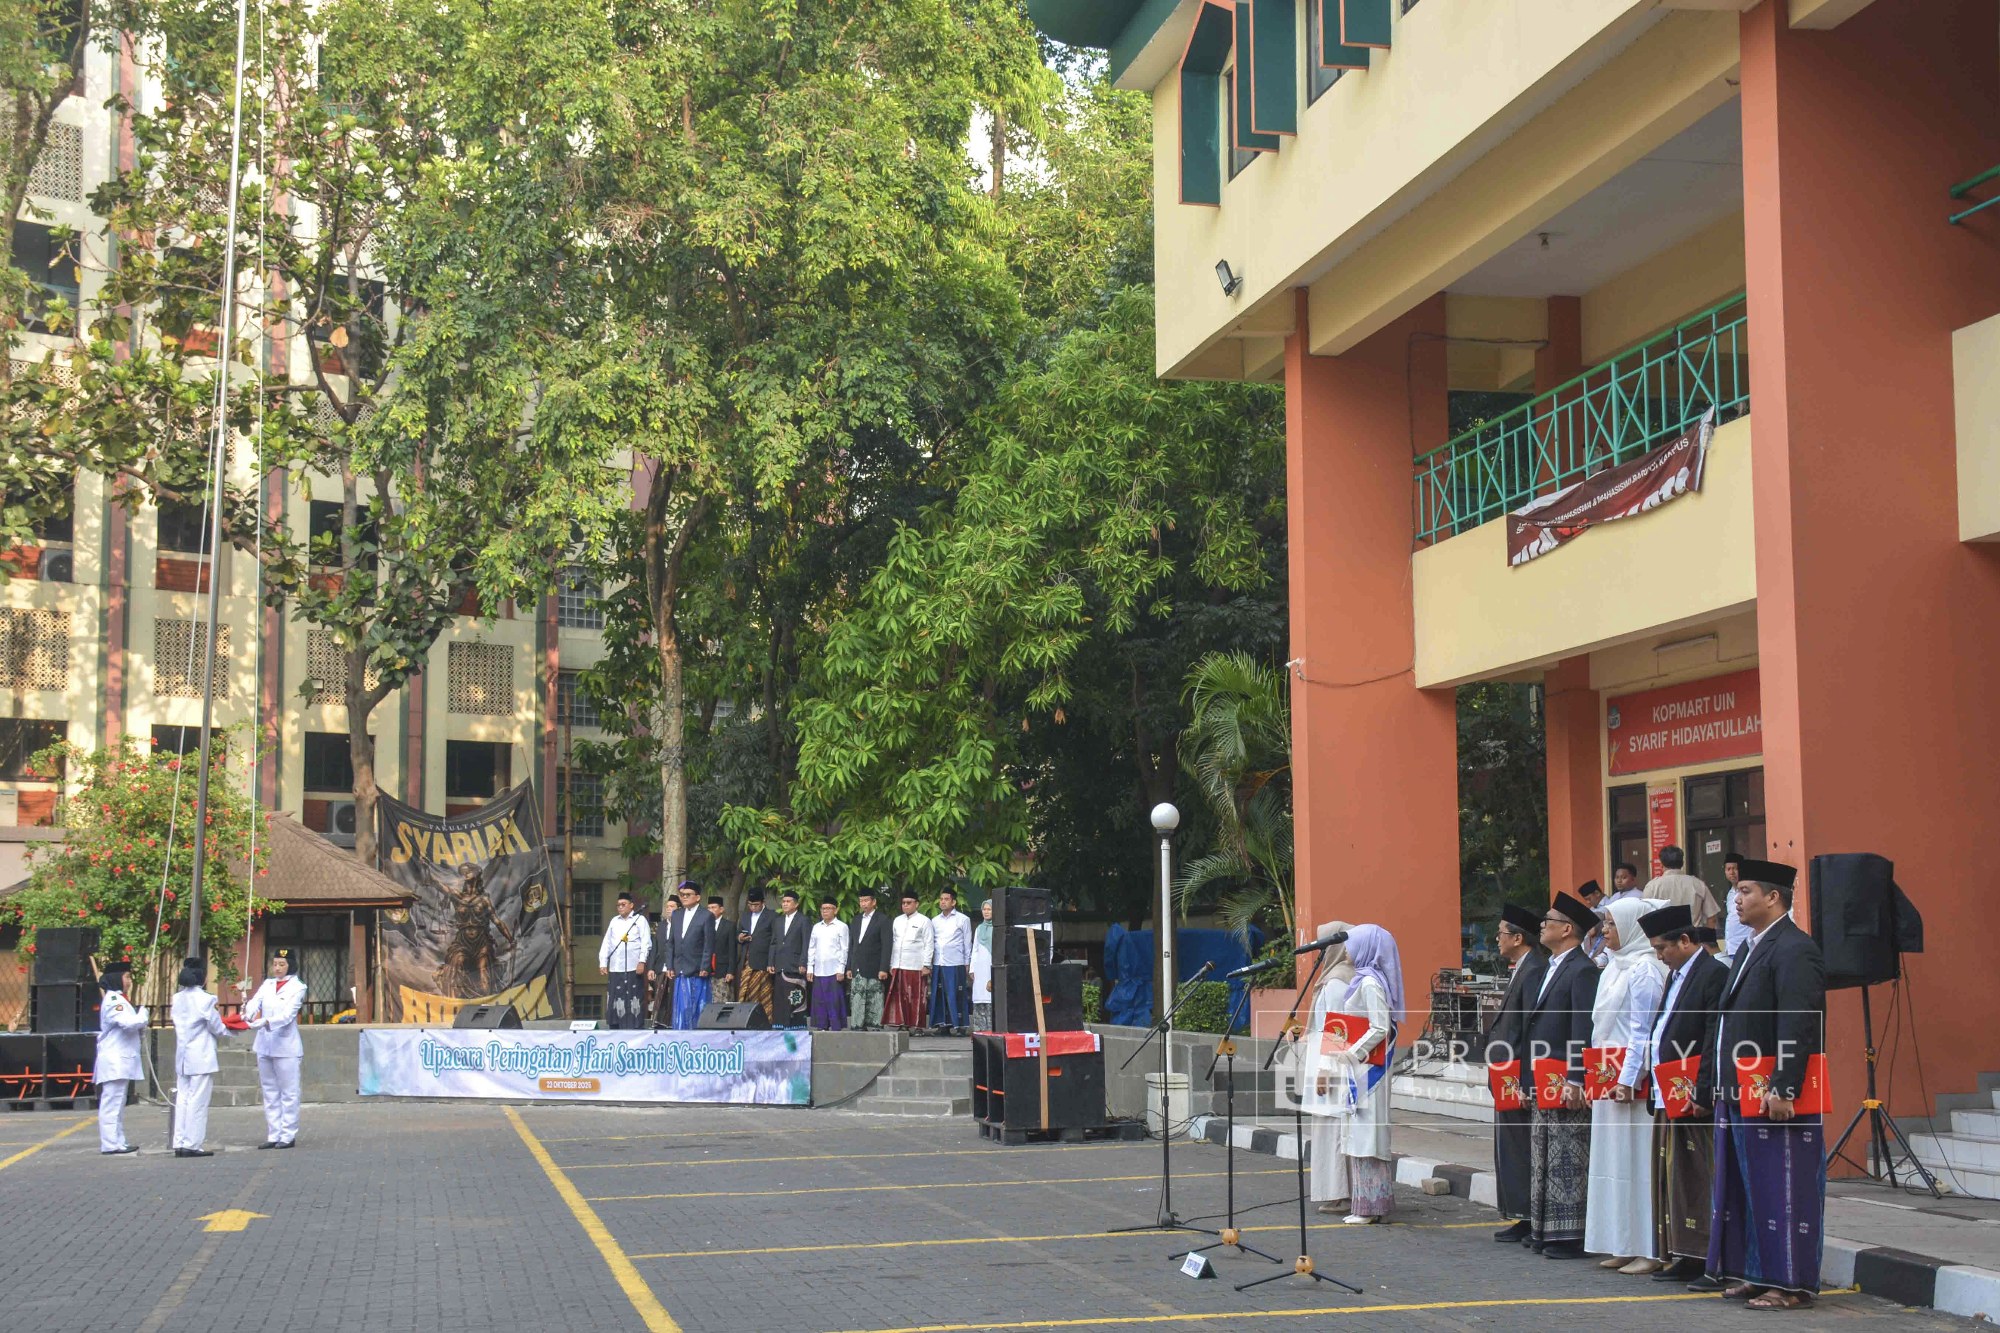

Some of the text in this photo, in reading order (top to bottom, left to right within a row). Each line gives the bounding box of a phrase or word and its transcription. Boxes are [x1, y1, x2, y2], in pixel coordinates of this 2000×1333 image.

[1653, 692, 1735, 724] KOPMART UIN
[1629, 715, 1762, 752] SYARIF HIDAYATULLAH
[391, 809, 531, 865] SYARIAH
[429, 821, 482, 831] FAKULTAS
[420, 1035, 744, 1078] Upacara Peringatan Hari Santri Nasional
[553, 1081, 577, 1089] OKTOBER
